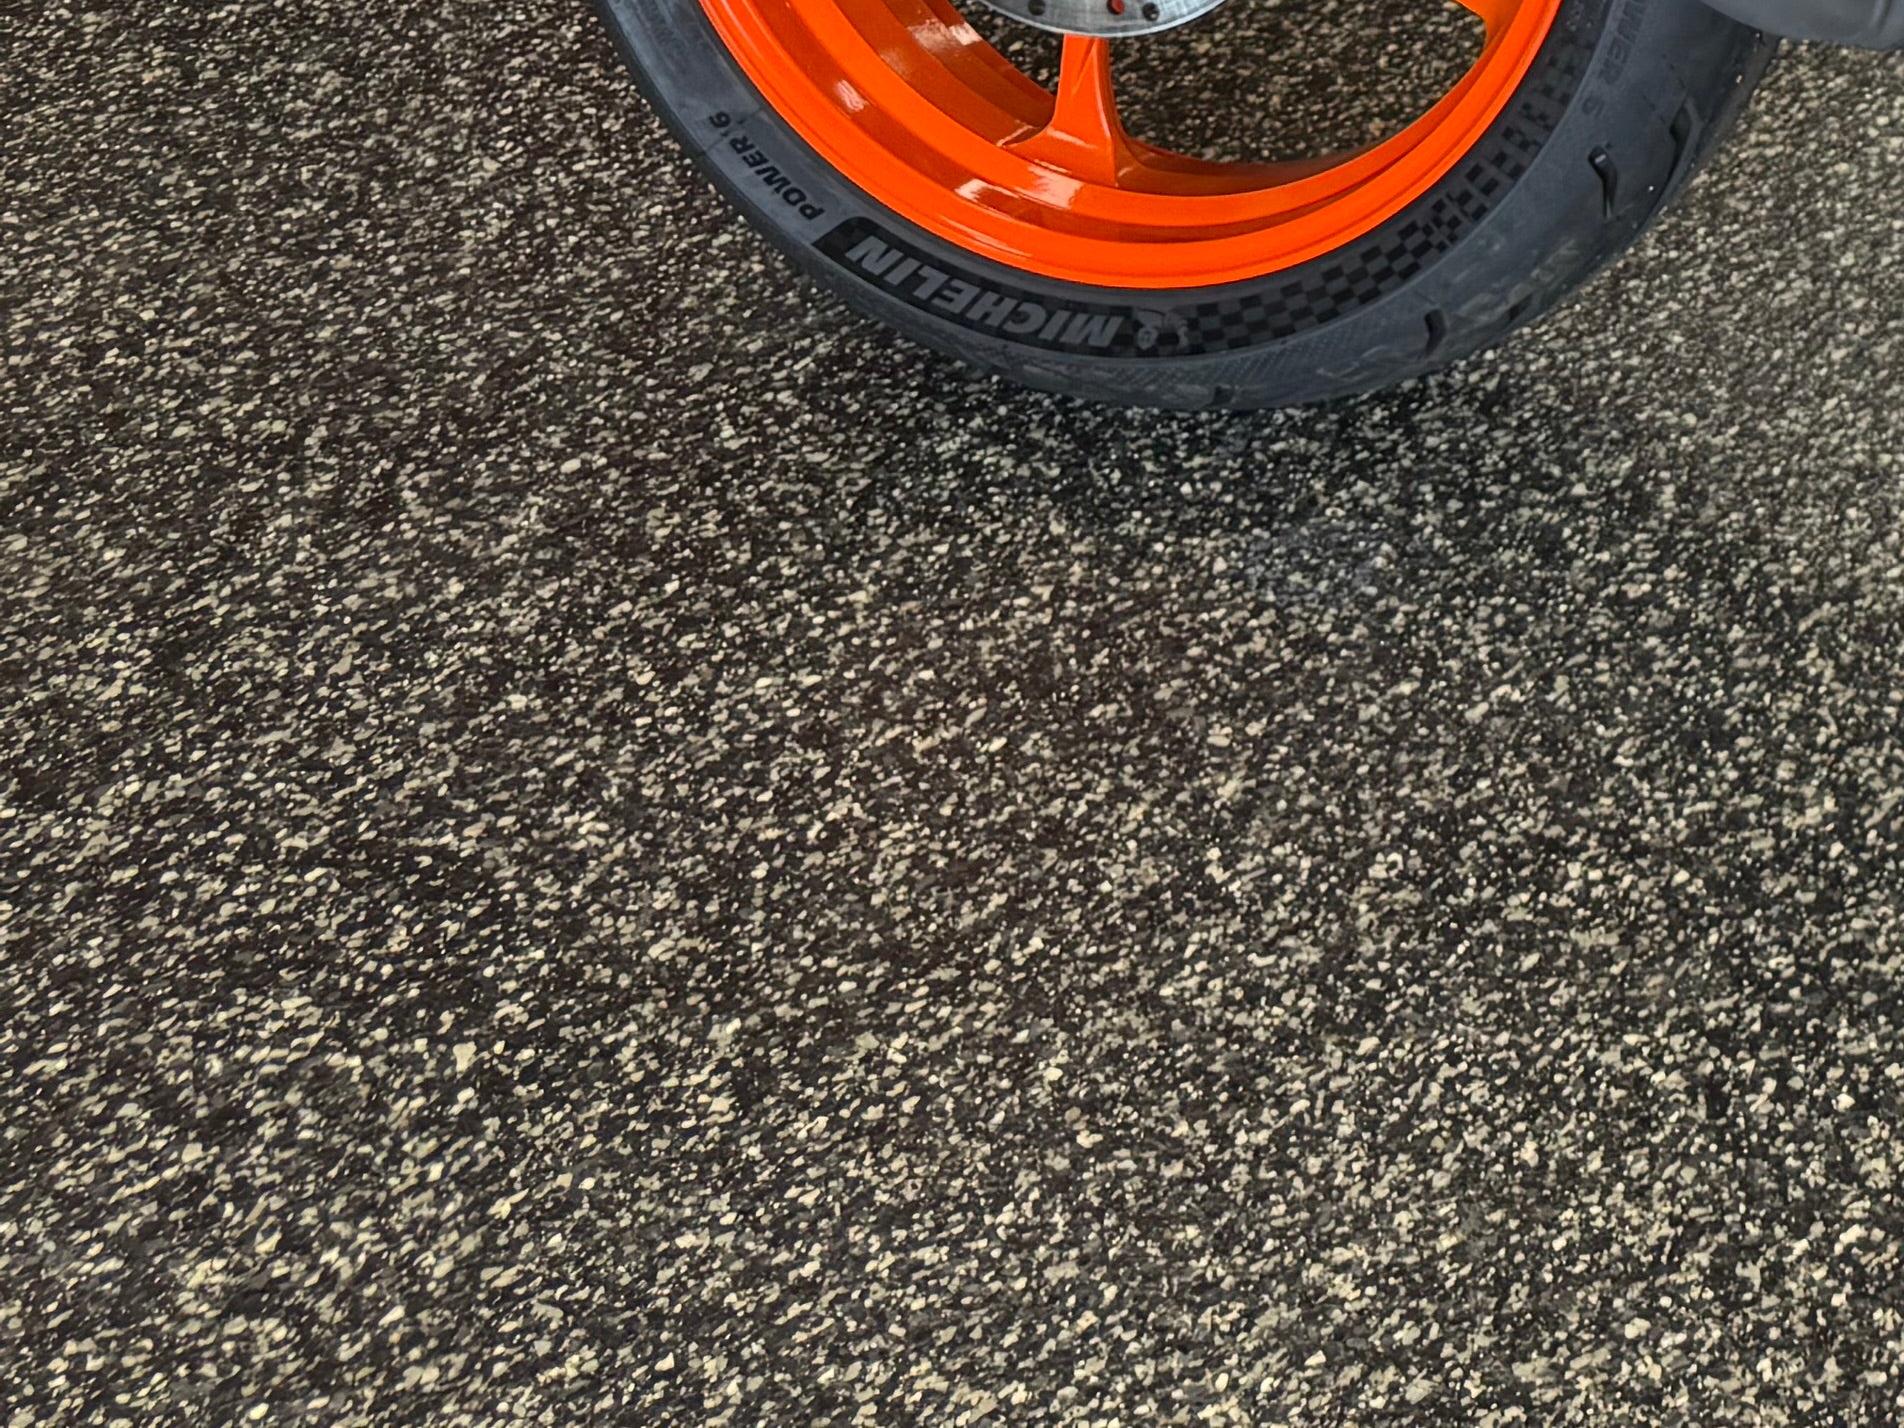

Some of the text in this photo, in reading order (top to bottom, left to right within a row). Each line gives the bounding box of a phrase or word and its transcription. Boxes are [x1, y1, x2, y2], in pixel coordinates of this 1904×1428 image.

[705, 106, 825, 222] POWER 6
[845, 232, 1125, 348] MICHELIN
